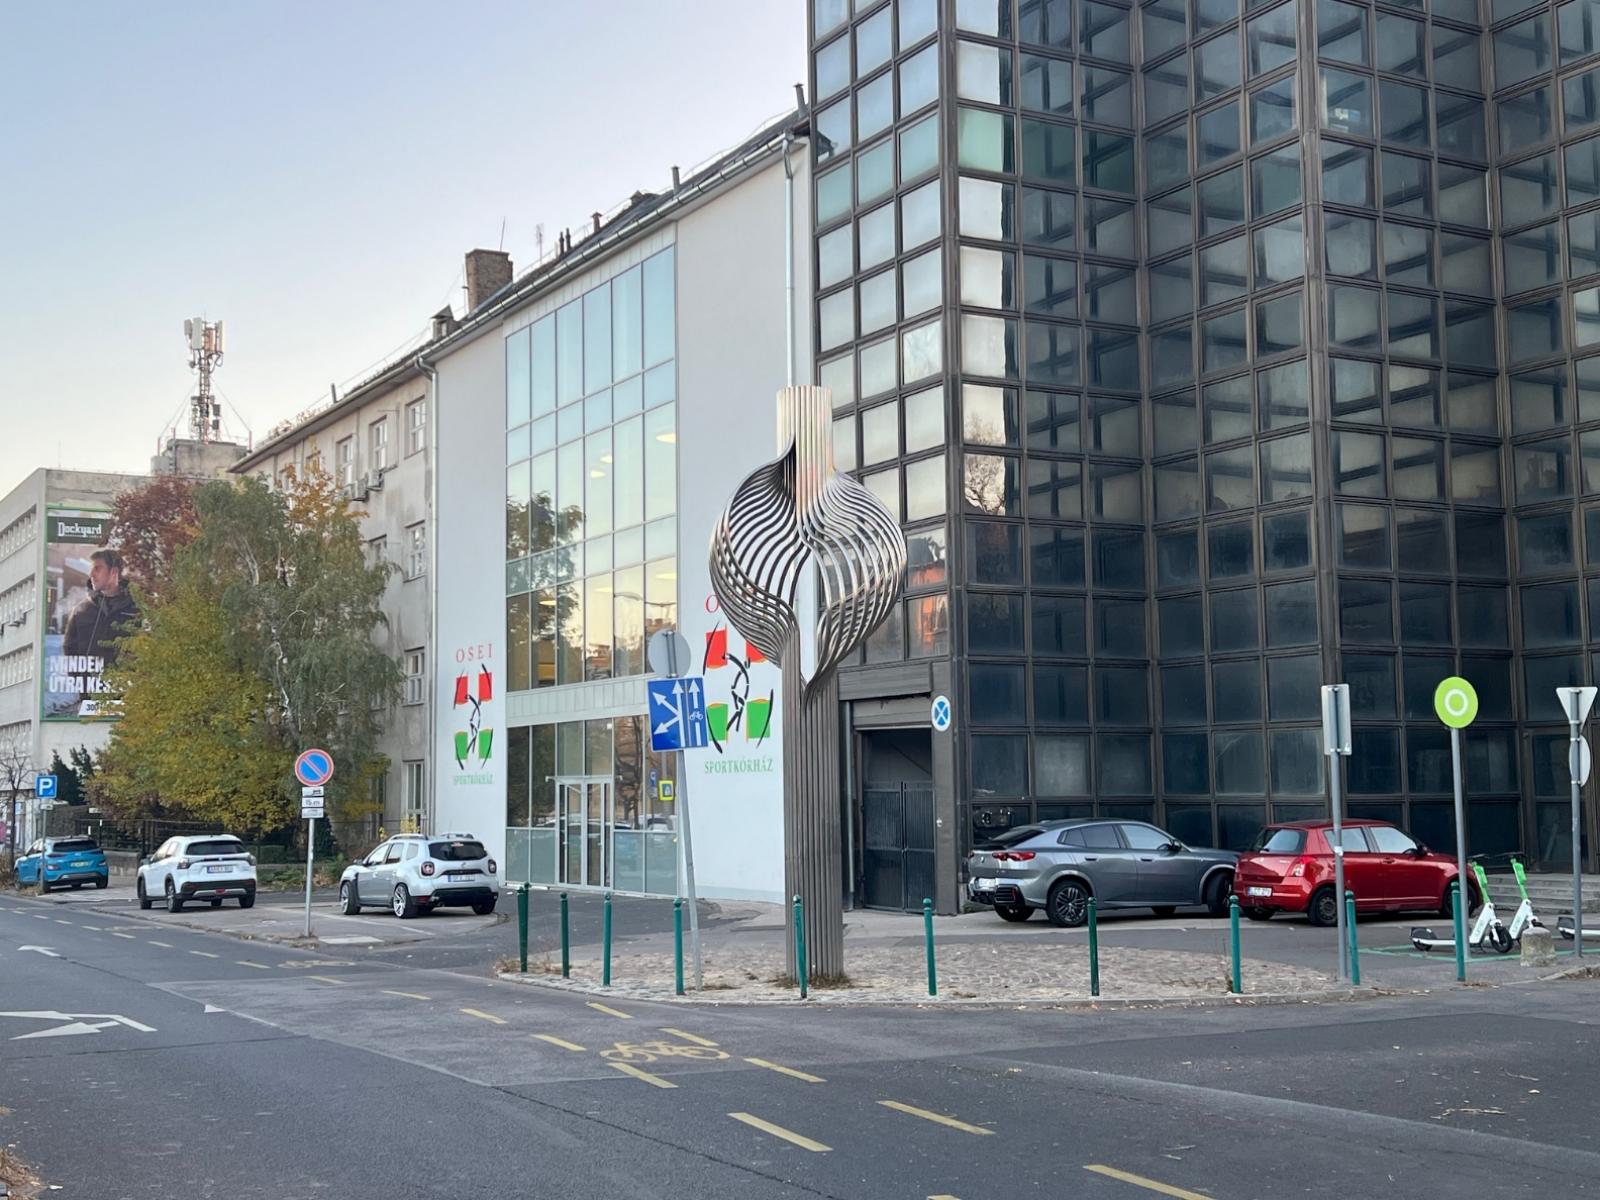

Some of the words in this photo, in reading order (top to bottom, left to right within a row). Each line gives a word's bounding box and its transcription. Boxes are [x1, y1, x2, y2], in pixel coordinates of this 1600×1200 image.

[57, 521, 102, 538] Dockyard
[455, 643, 493, 663] OSEI
[49, 655, 104, 673] MINDEN
[49, 673, 83, 693] ÚTRA
[704, 757, 773, 774] SPORTKÓRHÁZ
[39, 778, 53, 795] P
